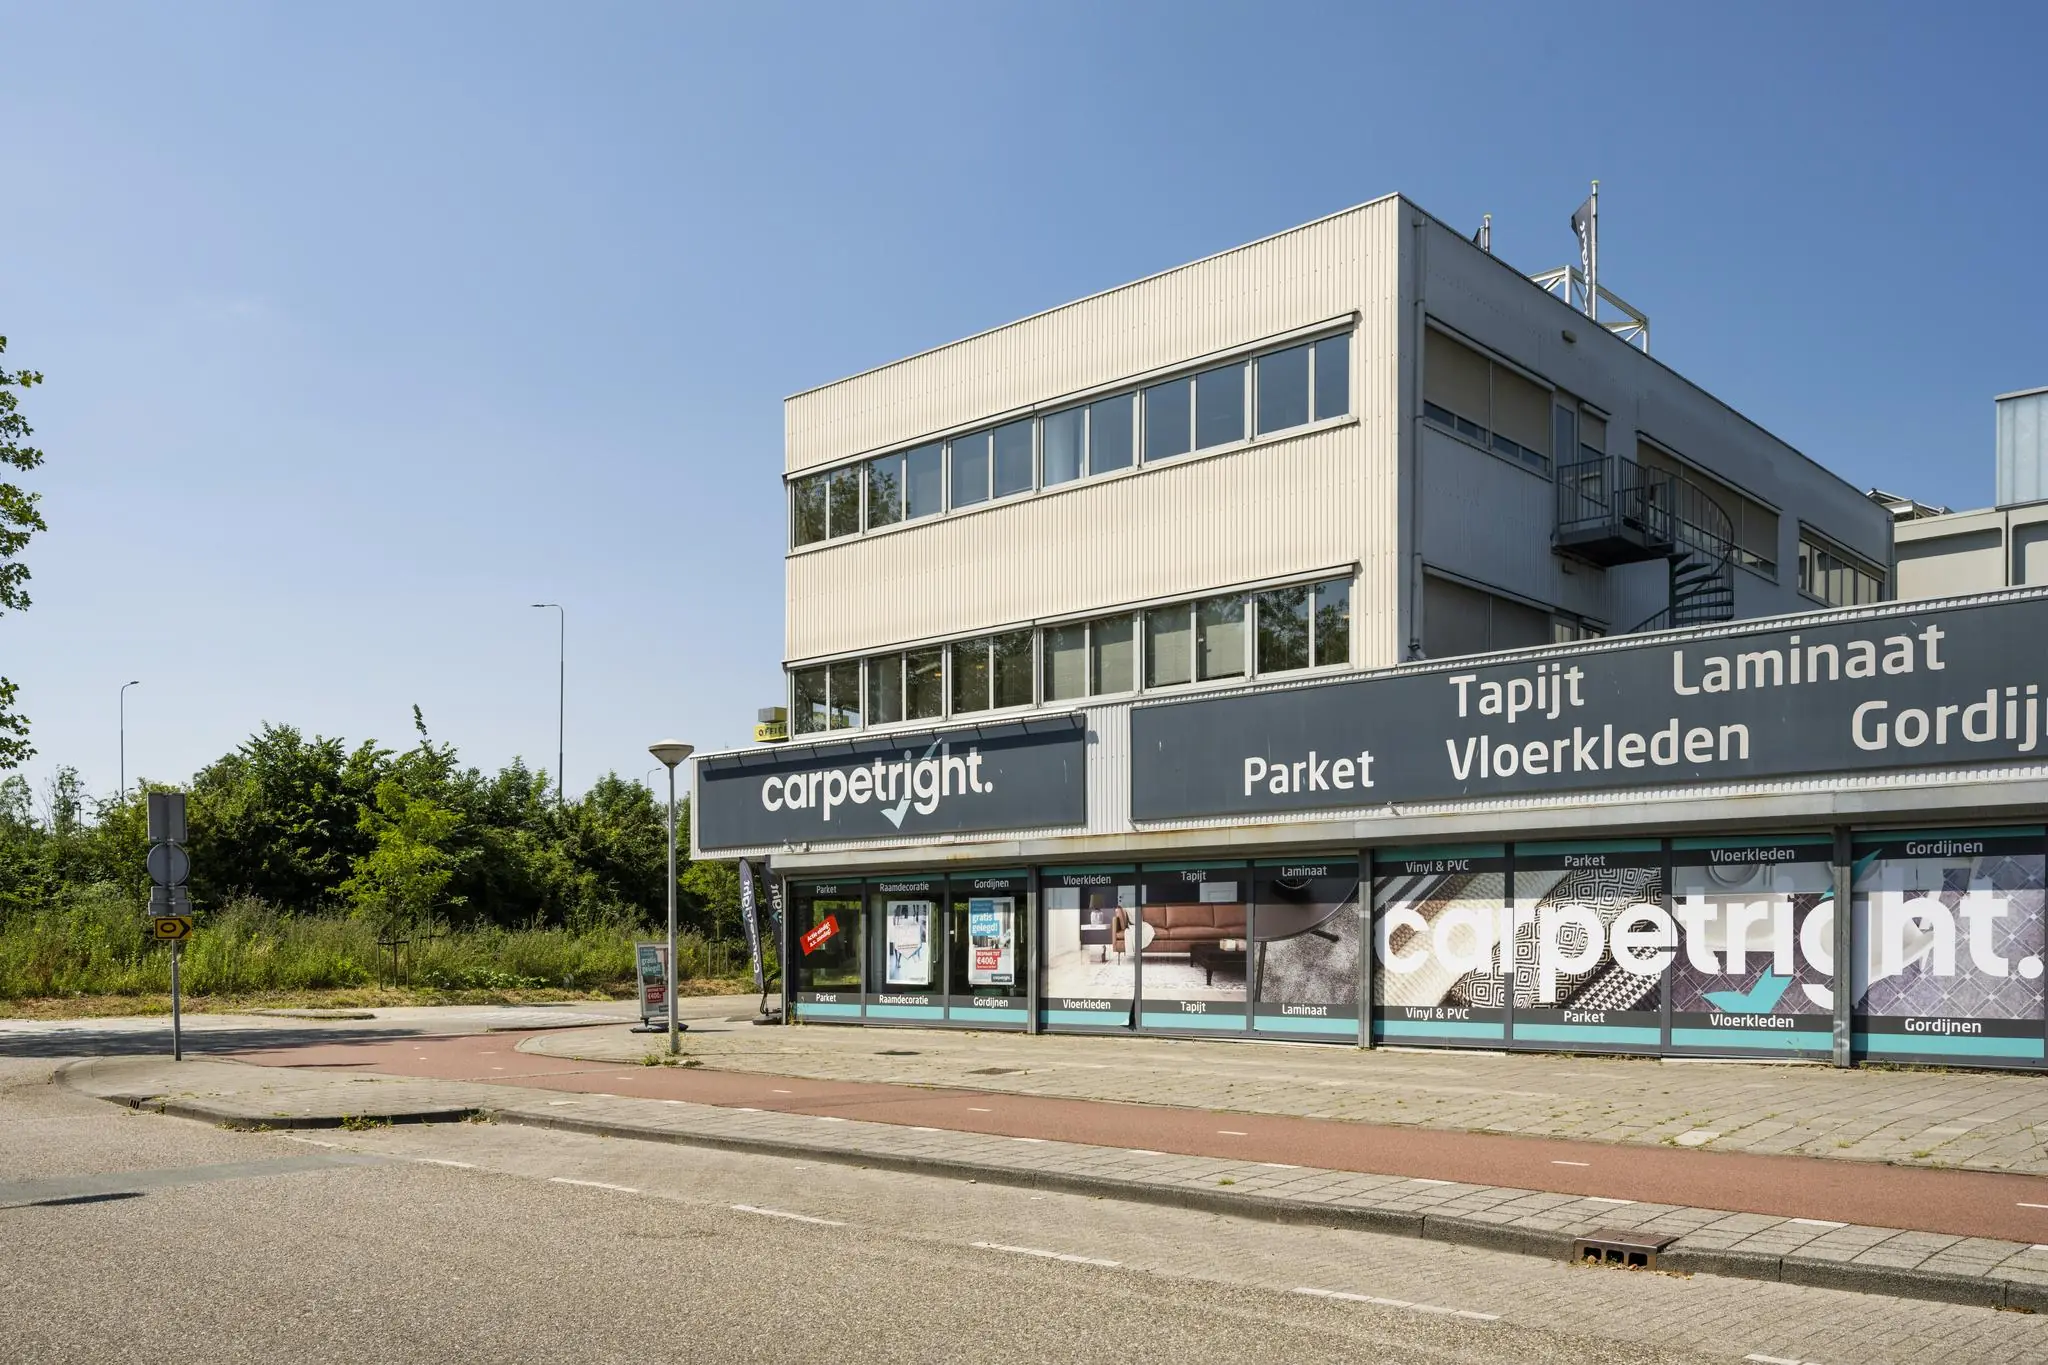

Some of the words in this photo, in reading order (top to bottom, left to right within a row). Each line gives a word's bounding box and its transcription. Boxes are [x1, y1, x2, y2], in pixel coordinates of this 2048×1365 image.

[1673, 624, 1945, 696] Laminaat
[1448, 663, 1585, 723] Tapijt
[1852, 685, 2048, 752] Gordij
[1446, 717, 1750, 781] Vloerkleden
[1243, 750, 1375, 796] Parket
[1906, 840, 1983, 857] Gordijnen
[1564, 854, 1606, 867] Parket
[1710, 848, 1795, 863] Vloerkleden
[1282, 866, 1327, 877] Laminaat
[1405, 860, 1433, 875] Vinyl
[1436, 861, 1445, 872] &
[1447, 859, 1469, 872] PVC
[1063, 874, 1112, 885] Vloerkleden
[1181, 870, 1207, 883] Tapijt
[816, 883, 837, 894] Parket
[879, 882, 929, 893] Raamdecoratie
[974, 878, 1009, 890] Gordijnen
[972, 912, 993, 923] gratis
[972, 923, 998, 934] gelegd!
[816, 993, 836, 1003] Parket
[879, 994, 929, 1005] Raamdecoratie
[973, 996, 1009, 1008] Gordijnen
[1063, 999, 1111, 1010] Vloerkleden
[1180, 1001, 1206, 1014] Tapijt
[1282, 1003, 1327, 1016] Laminaat
[1405, 1007, 1433, 1021] Vinyl
[1436, 1008, 1445, 1019] &
[1447, 1008, 1469, 1020] PVC
[1563, 1010, 1605, 1023] Parket
[1709, 1013, 1794, 1028] Vloerkleden
[1904, 1017, 1982, 1035] Gordijnen
